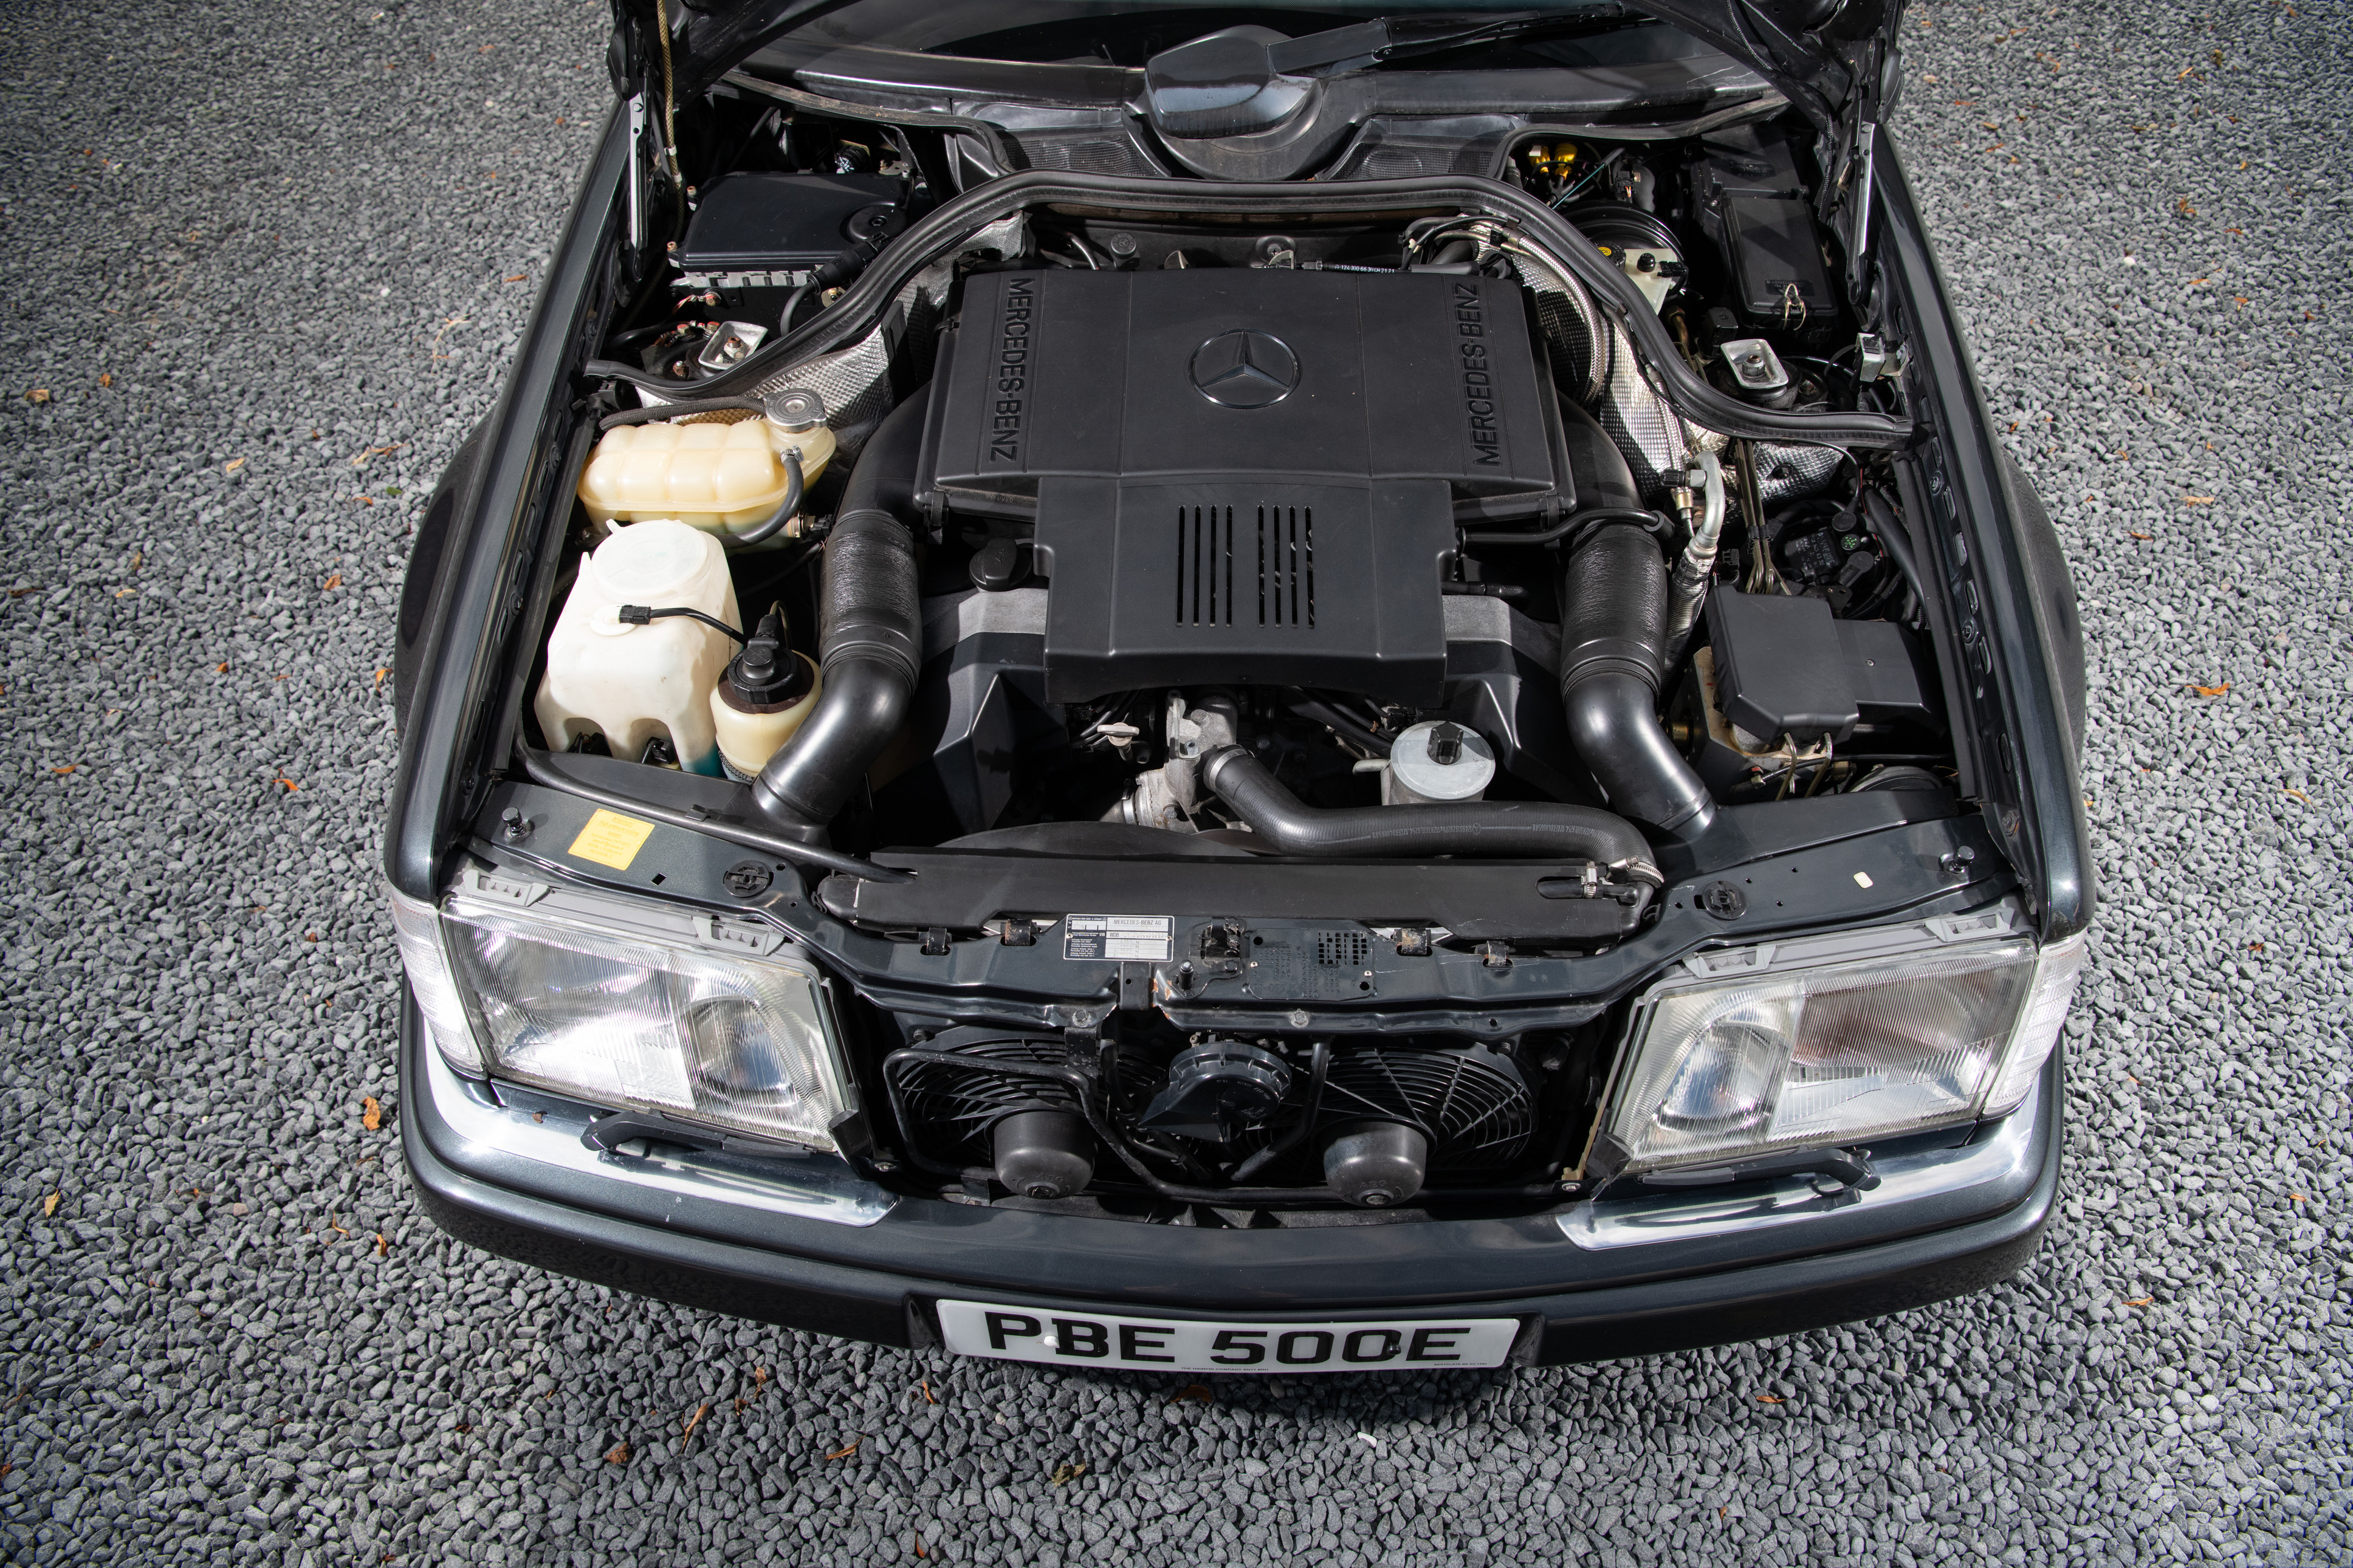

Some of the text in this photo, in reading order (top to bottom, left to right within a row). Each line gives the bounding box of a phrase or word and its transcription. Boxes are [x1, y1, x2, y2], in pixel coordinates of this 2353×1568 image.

[989, 278, 1035, 462] MERCEDES-BENZ
[1451, 282, 1502, 467] MERCEDES-BENZ
[609, 823, 625, 832] pressure
[612, 816, 635, 826] Attention!
[984, 1311, 1471, 1364] PBE 500E
